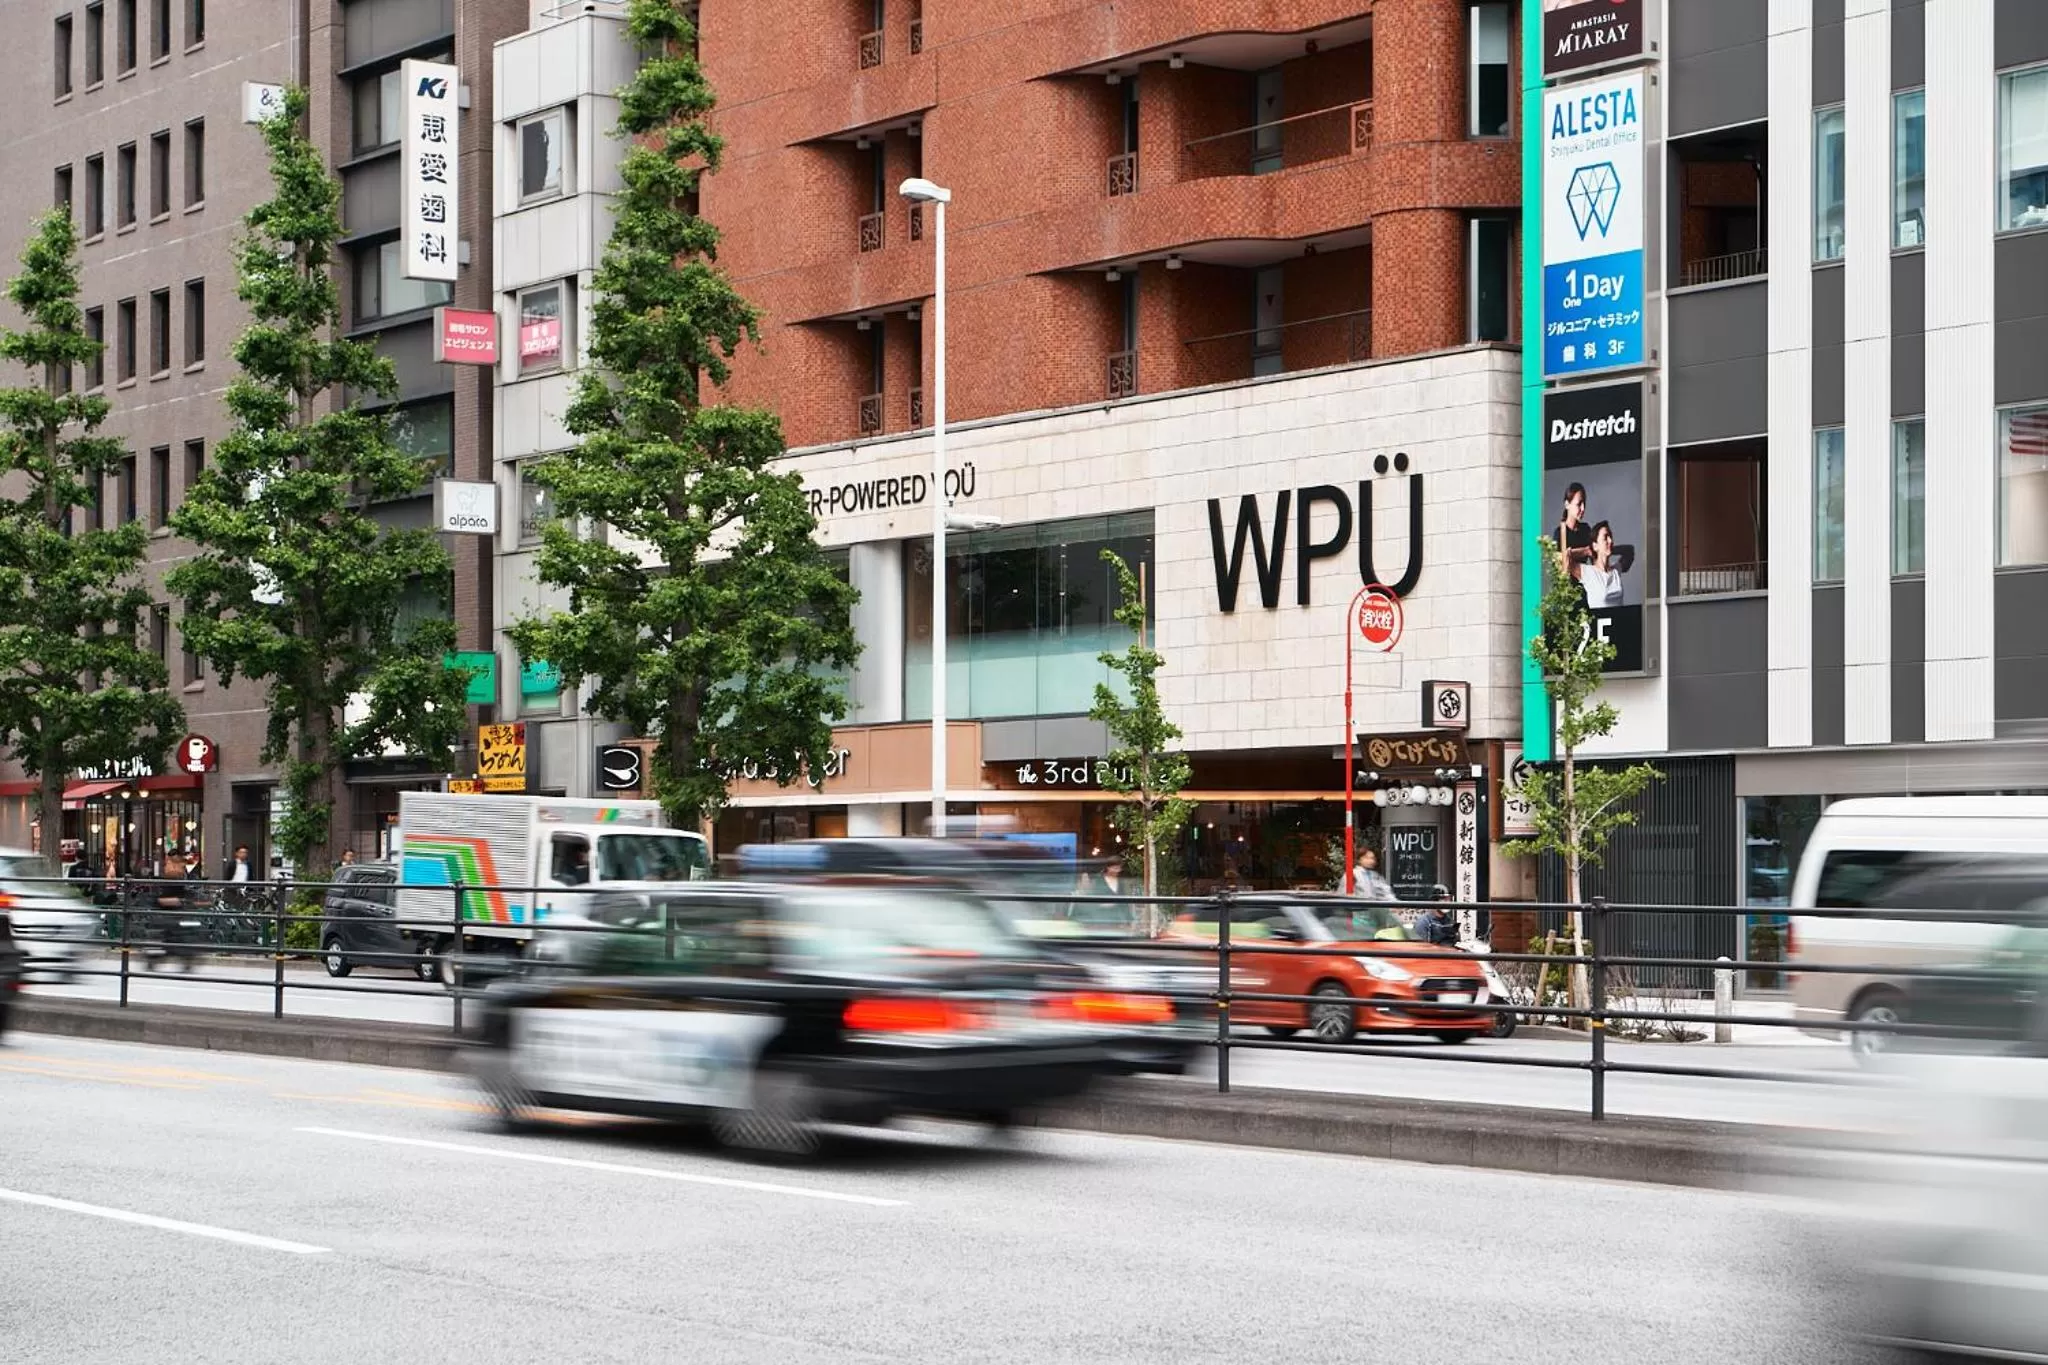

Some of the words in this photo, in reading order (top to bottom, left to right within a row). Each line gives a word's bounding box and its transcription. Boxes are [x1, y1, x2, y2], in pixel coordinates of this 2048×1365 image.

[1571, 12, 1617, 30] ANASTASIA
[1554, 23, 1630, 57] MIARAY
[1552, 88, 1637, 140] ALESTA
[1586, 136, 1612, 150] Dental
[1614, 131, 1638, 146] Office
[1583, 273, 1625, 301] Day
[1563, 297, 1581, 309] One
[1547, 309, 1641, 337] ジルコニア・セラミック
[1608, 339, 1625, 356] 3F
[1550, 409, 1636, 444] Dr.stretch
[931, 461, 976, 498] OÜ
[449, 513, 488, 528] alpaca
[1207, 452, 1424, 613] WPÜ
[1361, 608, 1393, 630] 消火栓
[1388, 737, 1458, 765] てけてけ
[1016, 764, 1038, 784] the
[1044, 761, 1087, 784] 3rd
[1393, 829, 1435, 851] WPÜ
